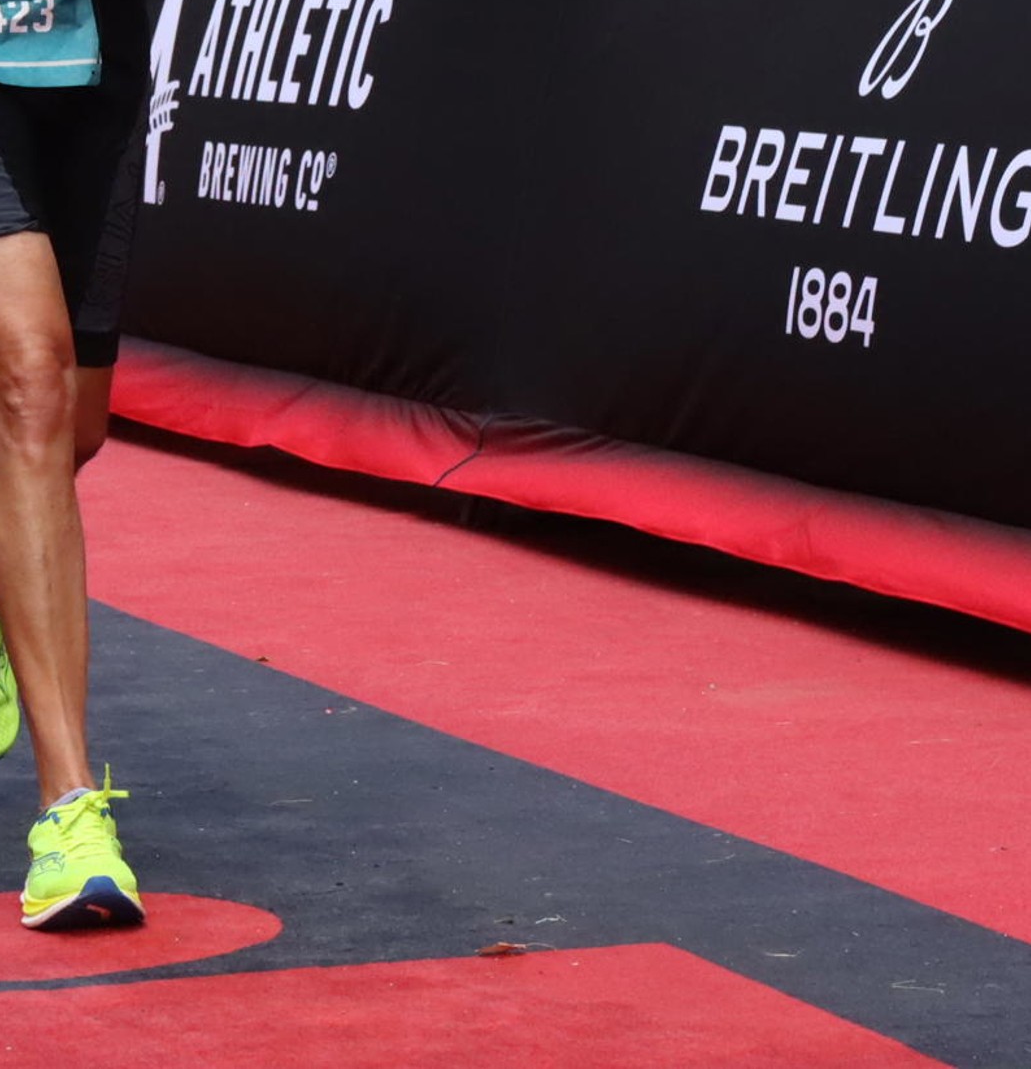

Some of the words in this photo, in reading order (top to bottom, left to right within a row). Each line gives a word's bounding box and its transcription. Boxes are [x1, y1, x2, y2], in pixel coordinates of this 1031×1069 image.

[198, 141, 291, 208] BREWING
[701, 125, 1031, 248] BREITLING
[785, 266, 878, 348] 1884
